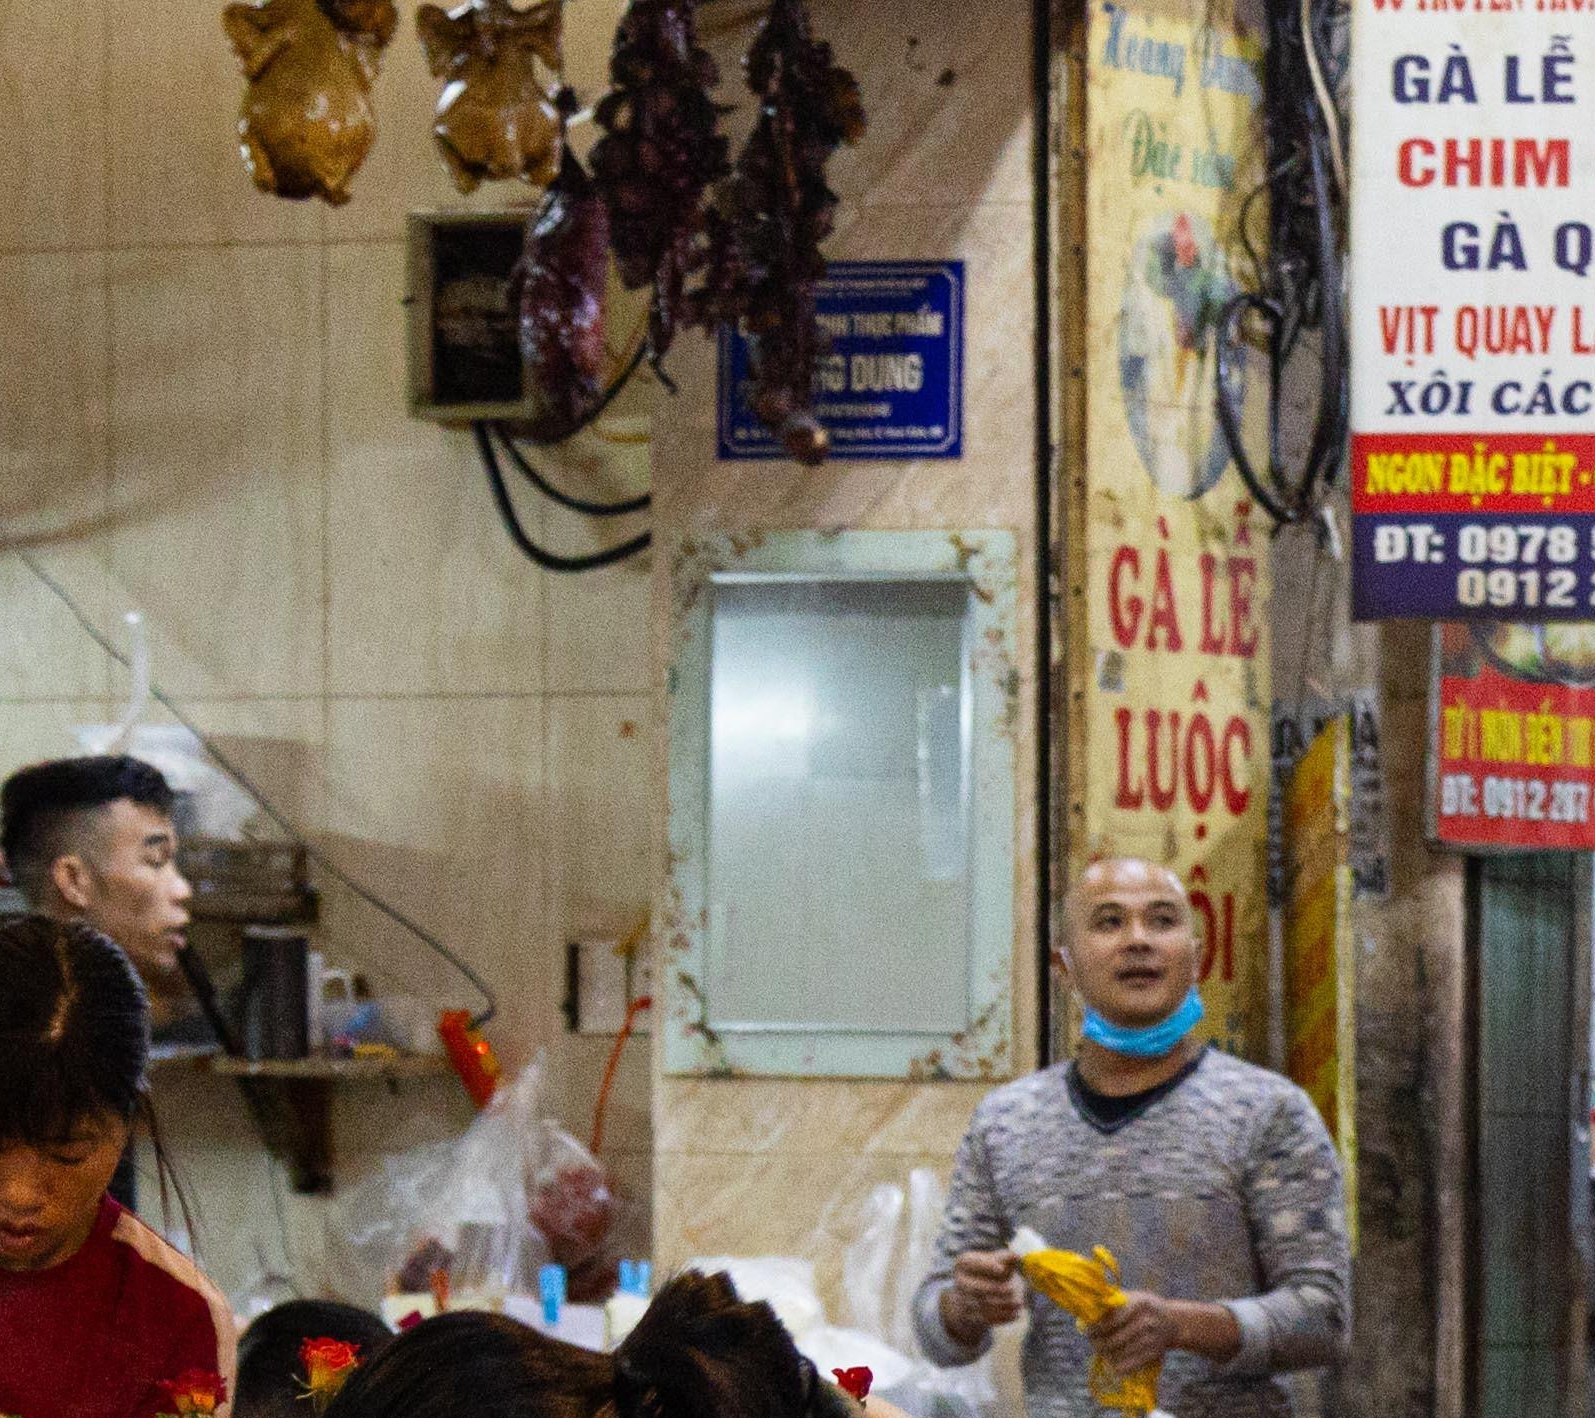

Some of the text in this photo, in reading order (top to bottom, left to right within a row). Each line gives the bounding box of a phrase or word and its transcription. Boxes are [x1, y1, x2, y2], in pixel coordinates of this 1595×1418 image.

[1391, 44, 1478, 105] GÀ
[1505, 35, 1576, 105] LỄ
[1396, 138, 1571, 189] CHIM
[1440, 212, 1529, 272] GÀ
[1379, 306, 1444, 366] VỊT
[1456, 309, 1557, 357] QUAY
[1384, 370, 1472, 417] XÔI
[1491, 369, 1593, 416] CÁC
[1365, 448, 1444, 495] NGON
[1447, 442, 1508, 507] ĐẶC
[1512, 441, 1576, 504] BIỆT
[1374, 528, 1446, 564] ĐT:
[1458, 527, 1578, 565] 0978
[1107, 517, 1184, 652] GÀ
[1457, 571, 1577, 609] 0912
[1115, 679, 1252, 840] LUỘC
